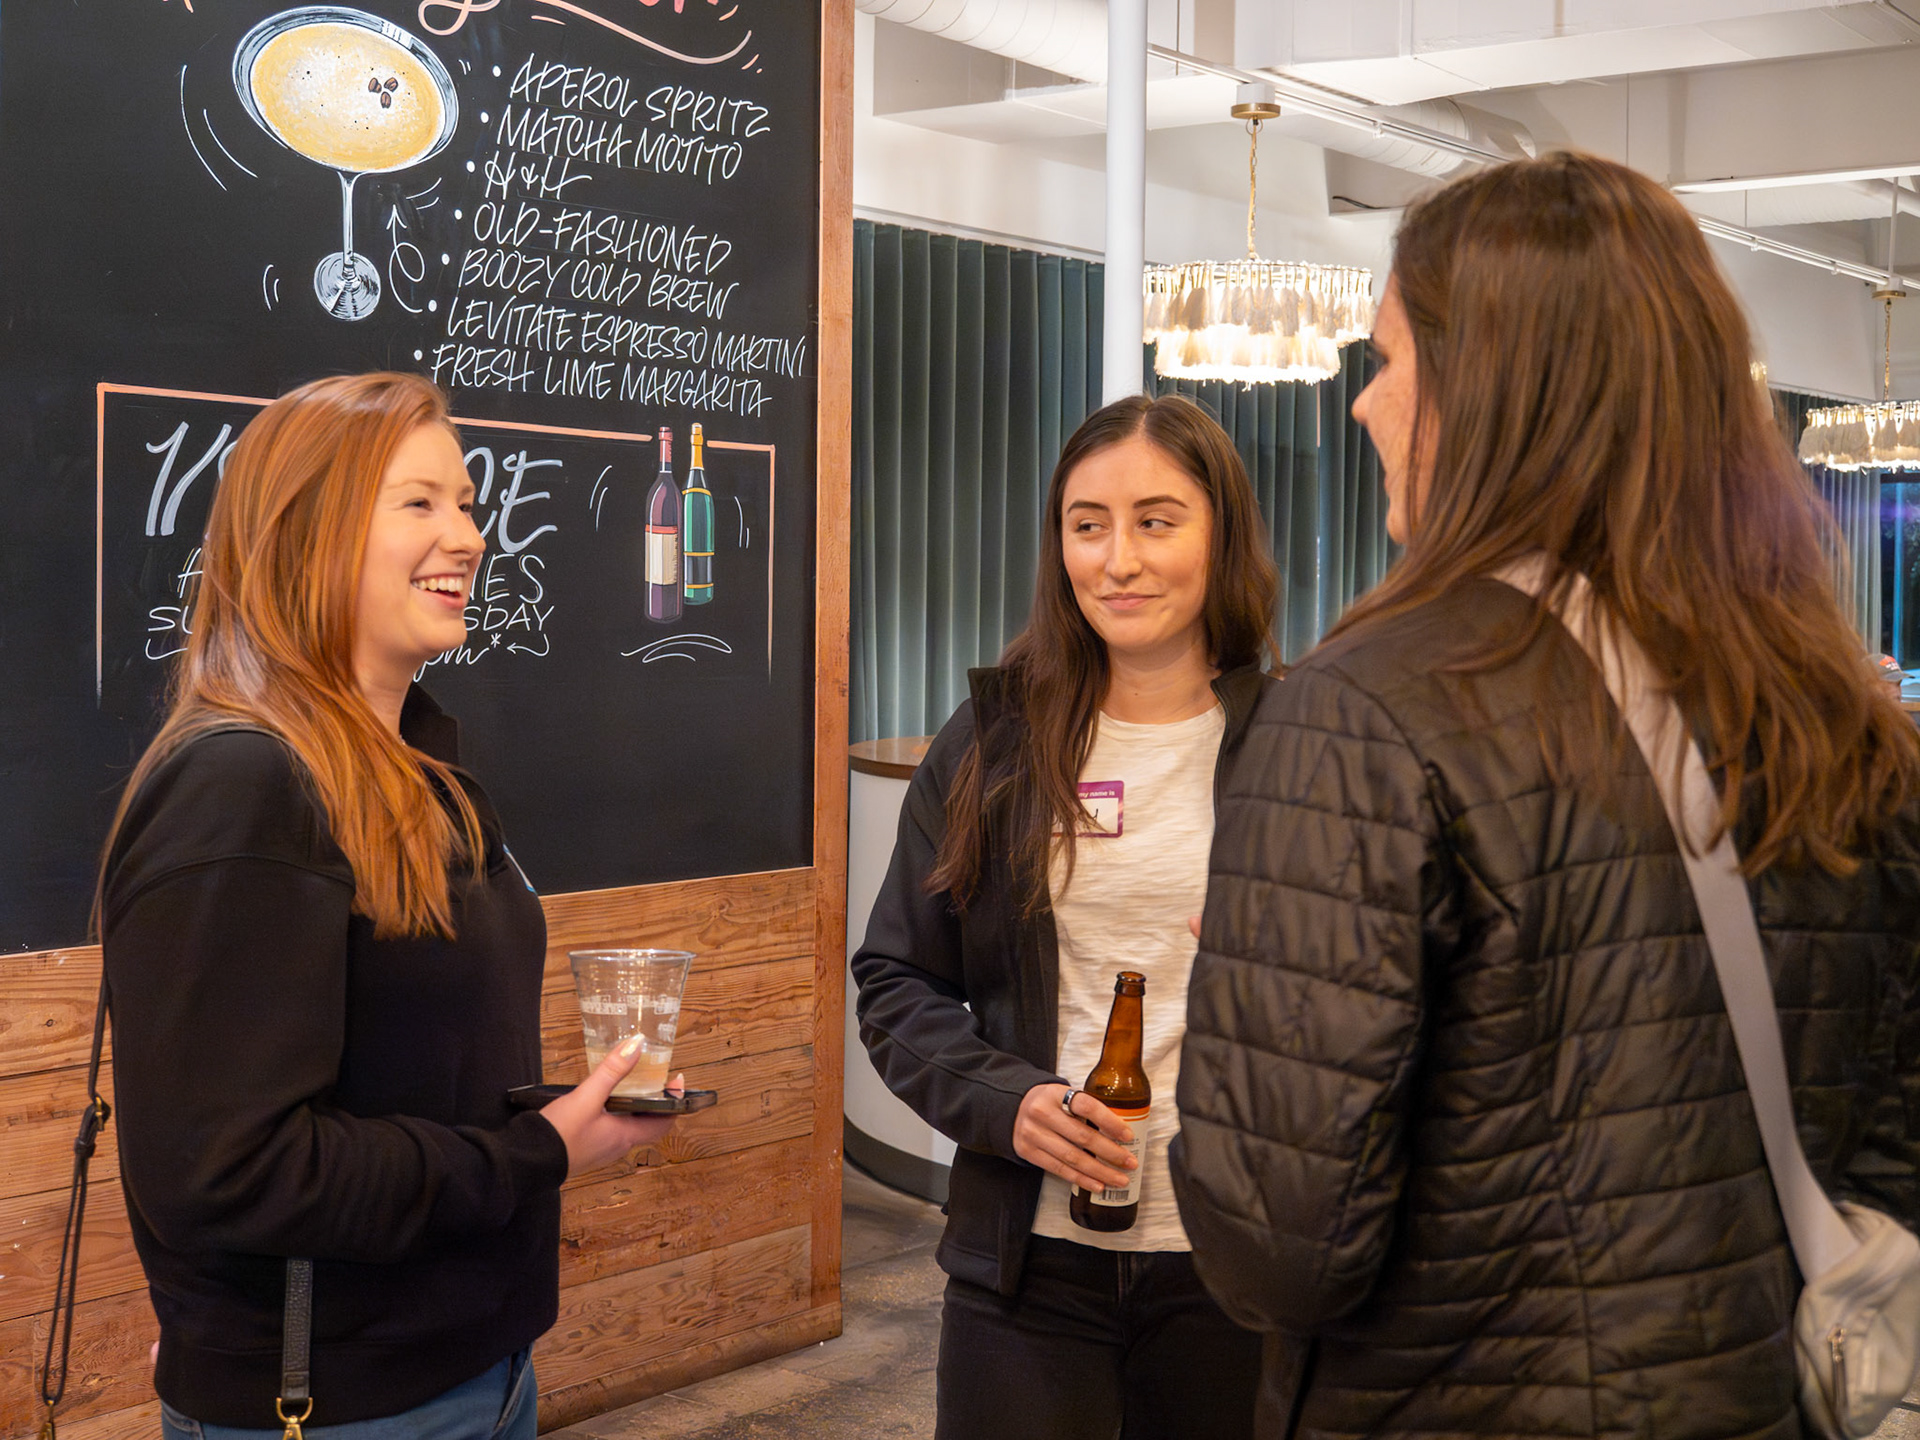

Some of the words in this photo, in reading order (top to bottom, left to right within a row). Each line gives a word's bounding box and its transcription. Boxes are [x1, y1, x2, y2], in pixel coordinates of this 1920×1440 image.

[510, 52, 638, 118] APEROL
[646, 86, 771, 138] SPRITZ
[496, 104, 633, 170] MATCHA
[634, 127, 743, 186] MOJITO
[474, 201, 733, 276] OLD-FASHIONED
[459, 248, 570, 299] BOOZY
[571, 260, 641, 307] COLD
[648, 268, 740, 320] BREW
[447, 296, 577, 352] LEVITATE
[581, 311, 708, 364] ESPRESSO
[712, 331, 806, 378] MARTINI
[430, 343, 535, 393] FRESH
[544, 356, 616, 400] LIME
[619, 362, 773, 418] MARGARITA
